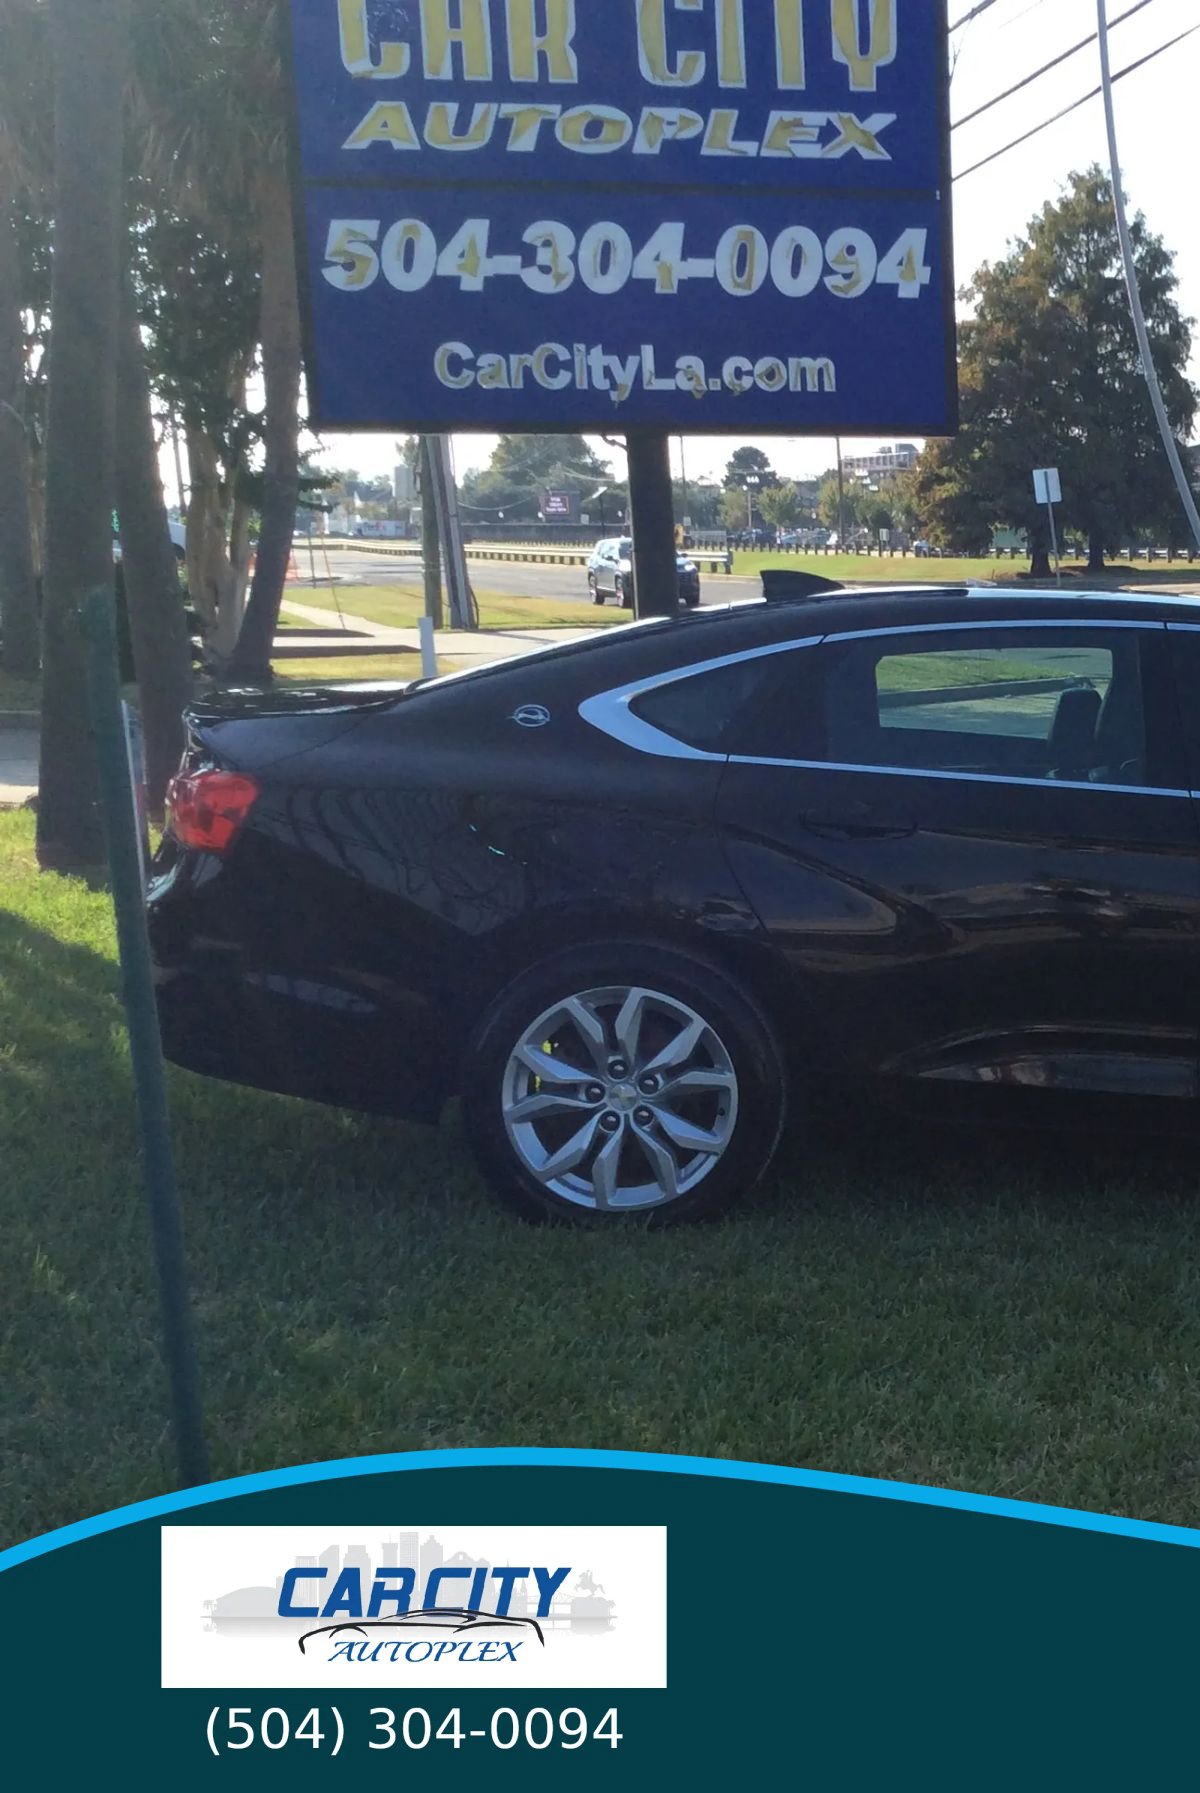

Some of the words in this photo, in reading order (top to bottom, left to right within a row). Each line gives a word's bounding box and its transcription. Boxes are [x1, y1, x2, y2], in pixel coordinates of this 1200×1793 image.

[337, 0, 579, 85] CAR
[635, 0, 899, 93] CITY
[341, 100, 898, 162] AUTOPLEX
[321, 217, 932, 300] 504-304-0094
[433, 341, 836, 404] CarCityLa.com
